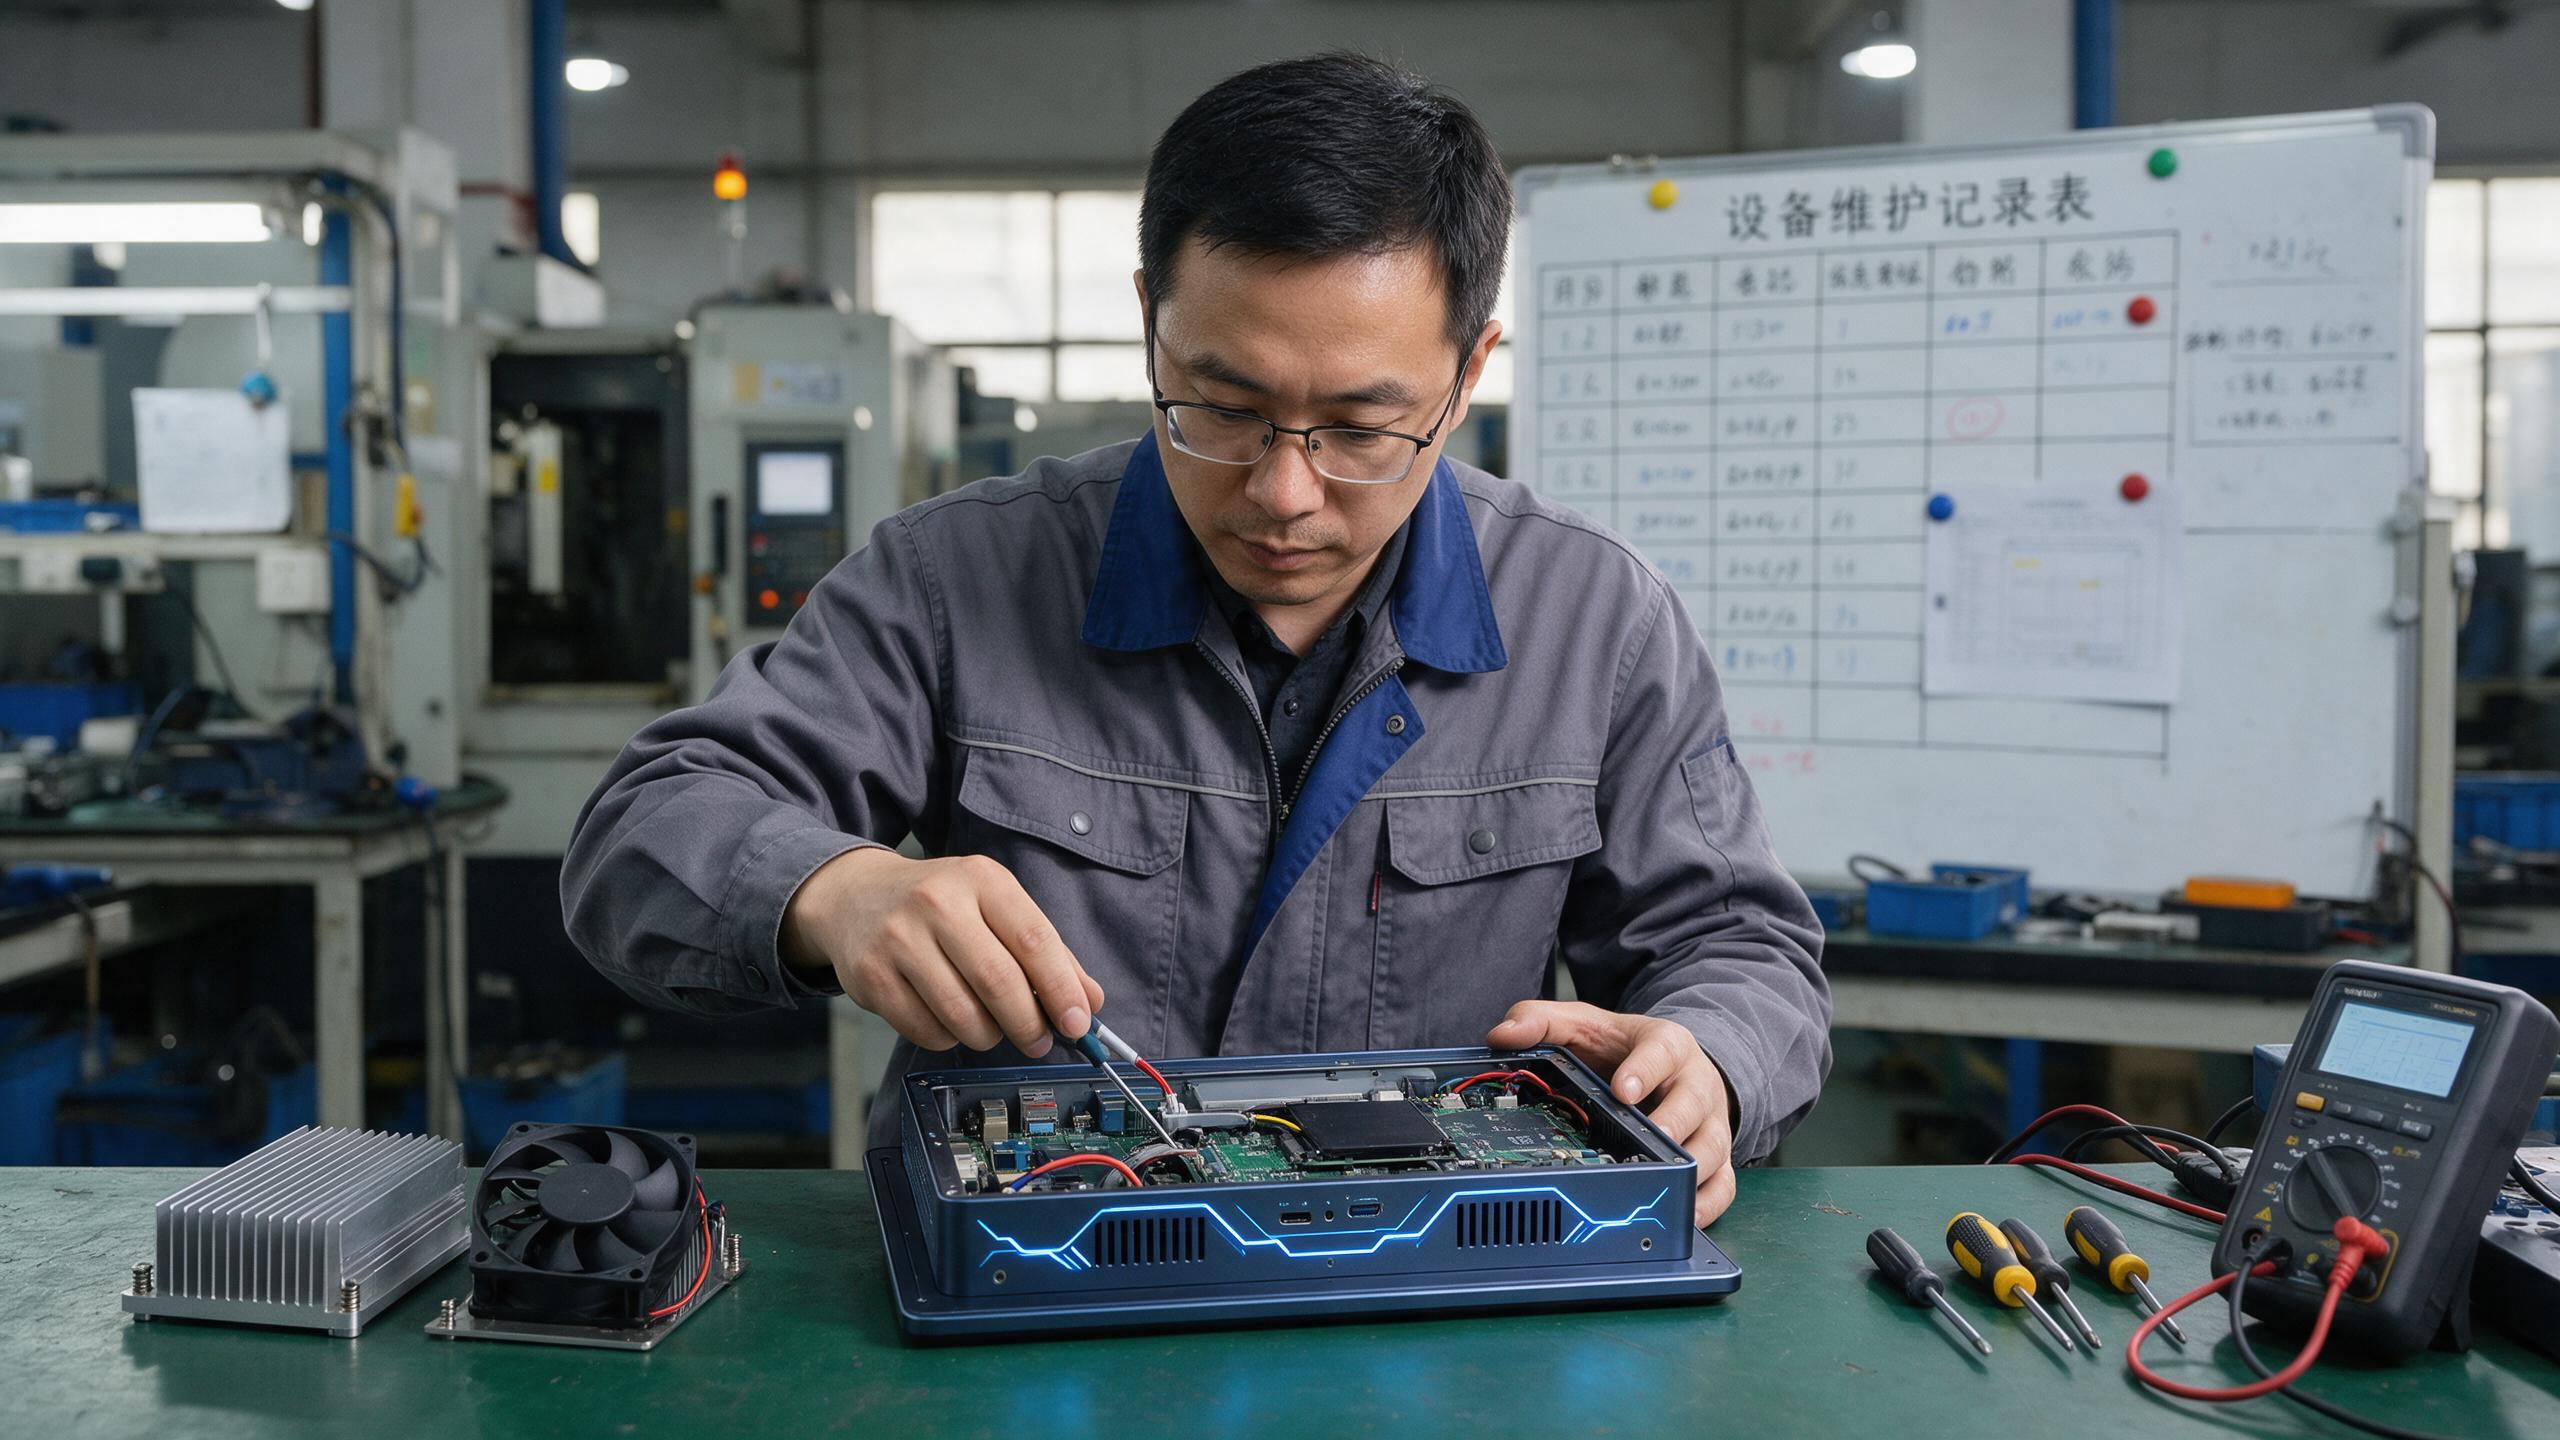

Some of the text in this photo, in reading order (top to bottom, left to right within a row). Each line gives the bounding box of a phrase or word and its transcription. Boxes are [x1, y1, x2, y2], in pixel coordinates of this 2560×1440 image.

[1727, 172, 2094, 242] 设备维护记录表
